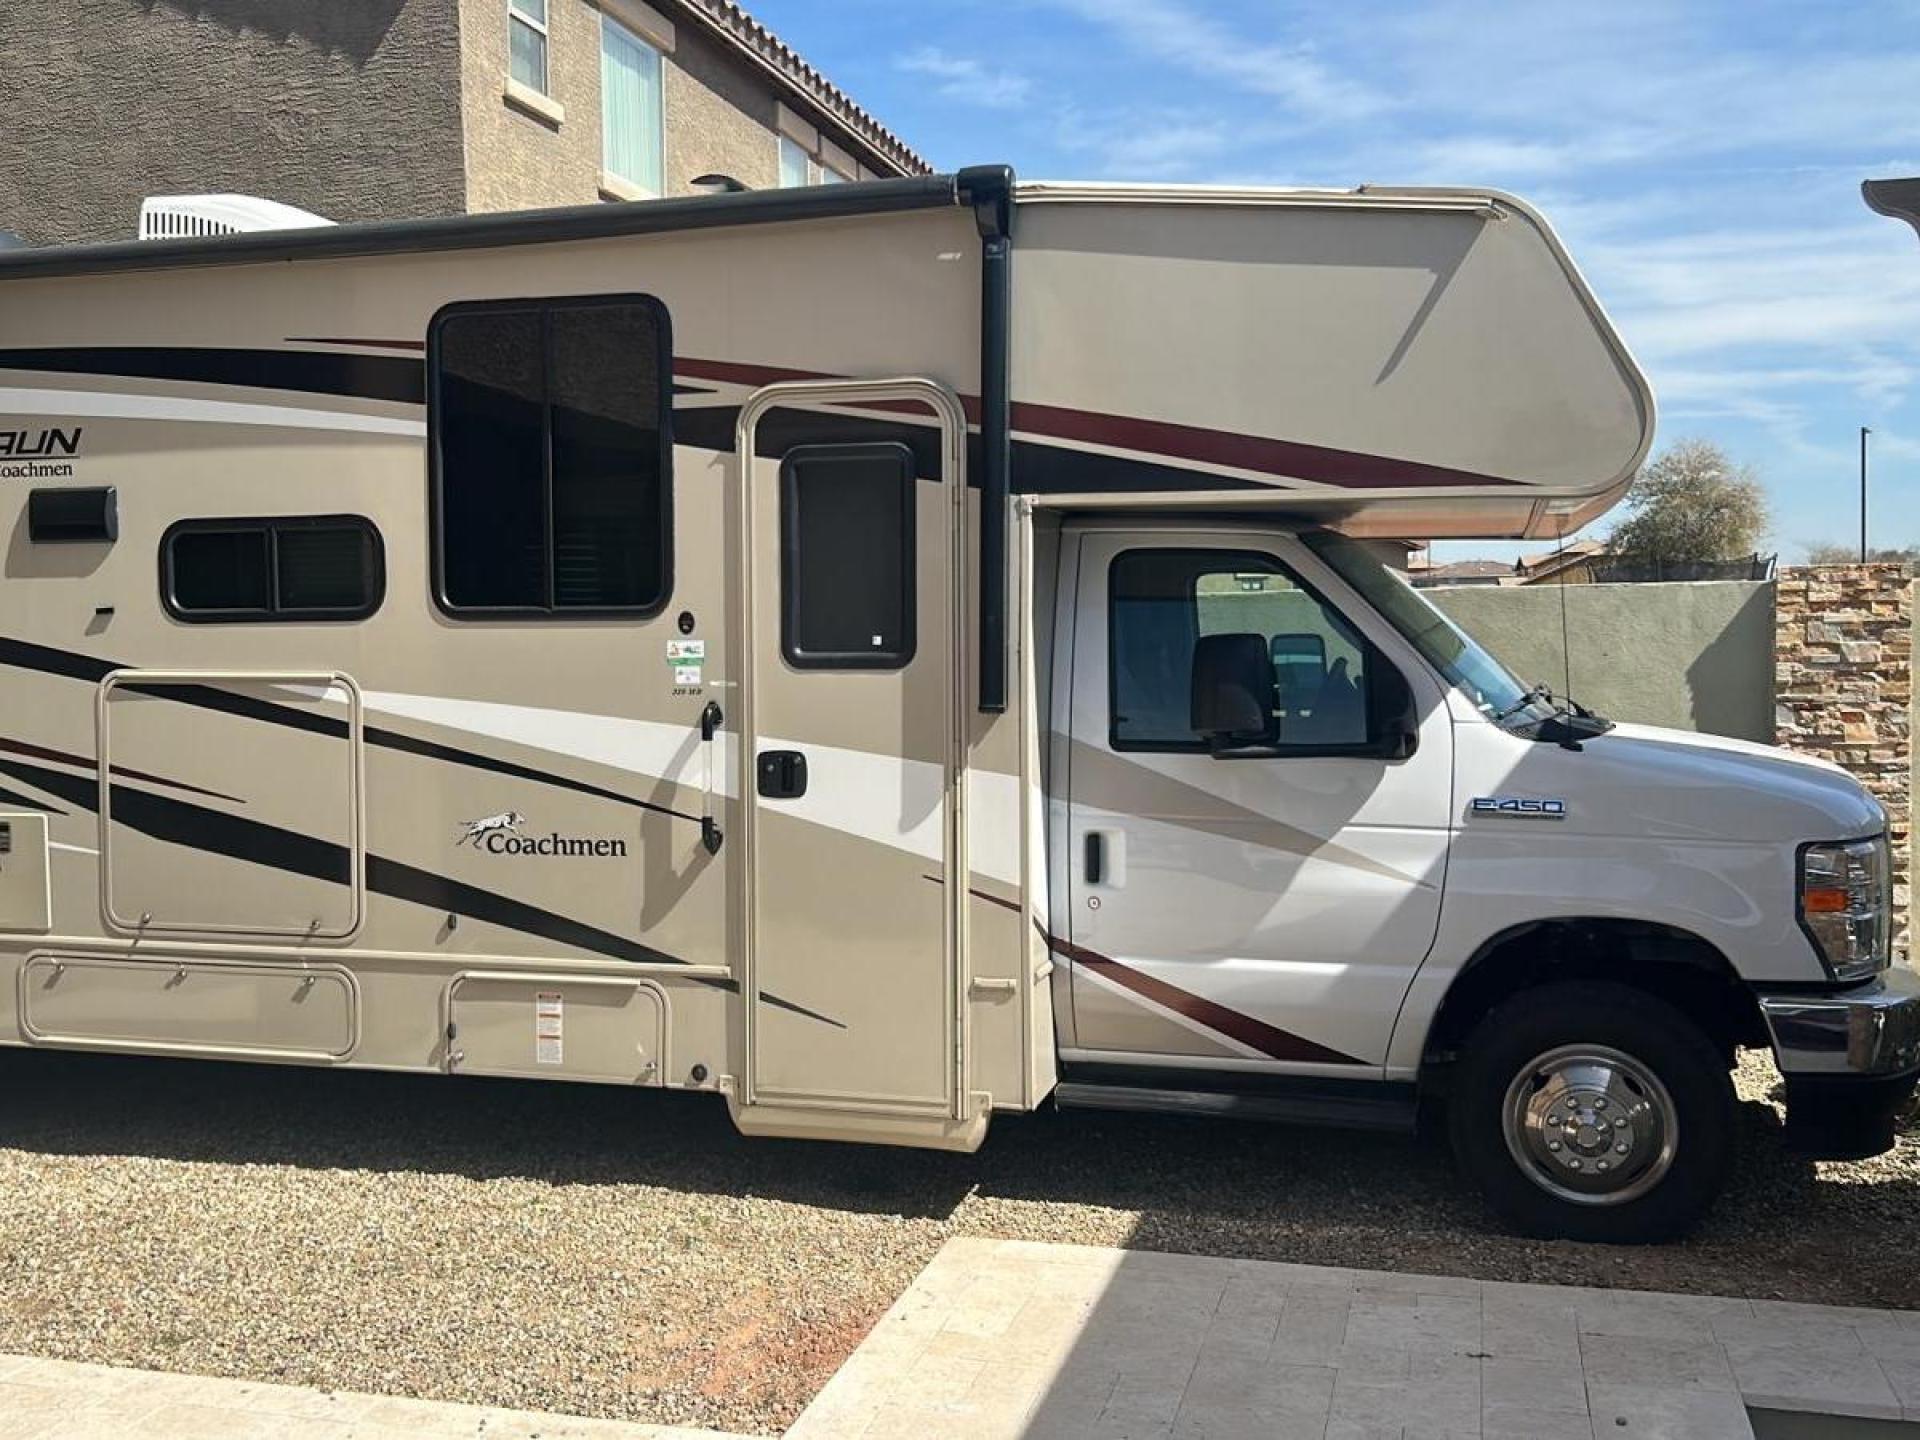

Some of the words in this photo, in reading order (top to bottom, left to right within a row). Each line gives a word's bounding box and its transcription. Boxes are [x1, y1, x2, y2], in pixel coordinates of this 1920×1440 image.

[0, 462, 73, 477] oachmen
[1473, 798, 1565, 815] E450
[486, 833, 627, 857] Coachmen
